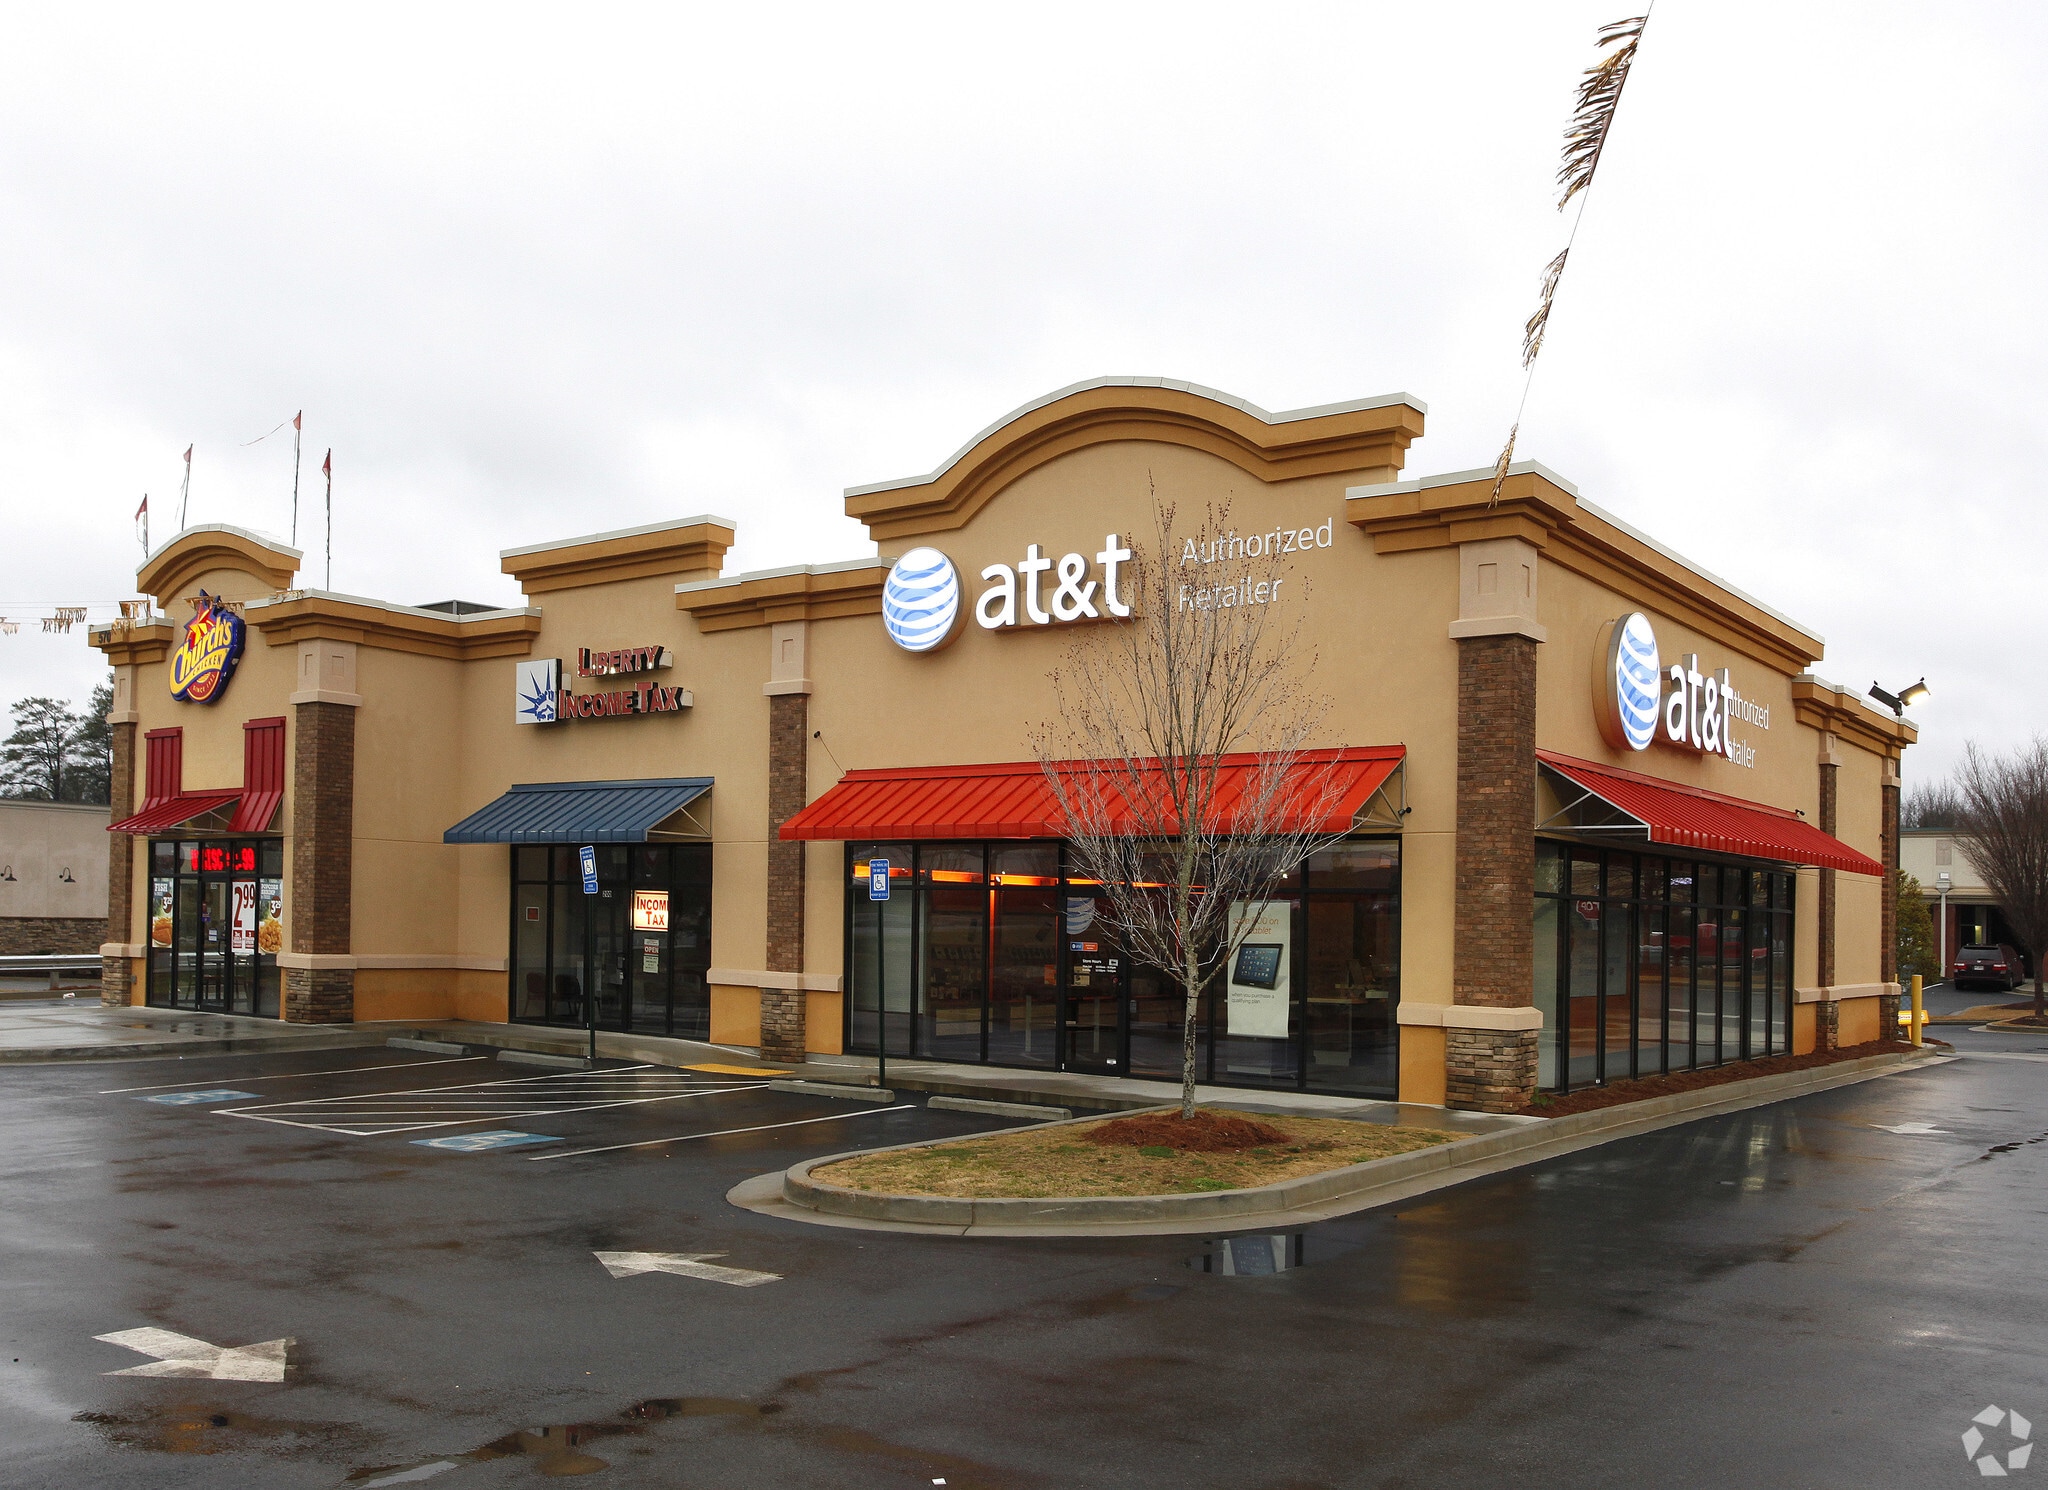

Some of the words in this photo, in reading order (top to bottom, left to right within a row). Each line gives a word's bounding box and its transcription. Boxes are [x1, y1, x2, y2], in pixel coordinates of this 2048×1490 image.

[1180, 517, 1333, 567] Authorized
[975, 533, 1131, 630] at&t
[1179, 576, 1284, 612] Retailer
[169, 616, 233, 695] Church's
[192, 653, 222, 677] CHICKEN
[577, 645, 660, 678] LIBERTY
[558, 689, 634, 720] INCOME
[634, 682, 678, 713] TAX
[1666, 653, 1734, 759] at&t
[1729, 691, 1769, 730] uthorized
[645, 911, 665, 926] TAX
[644, 946, 659, 954] OPEN
